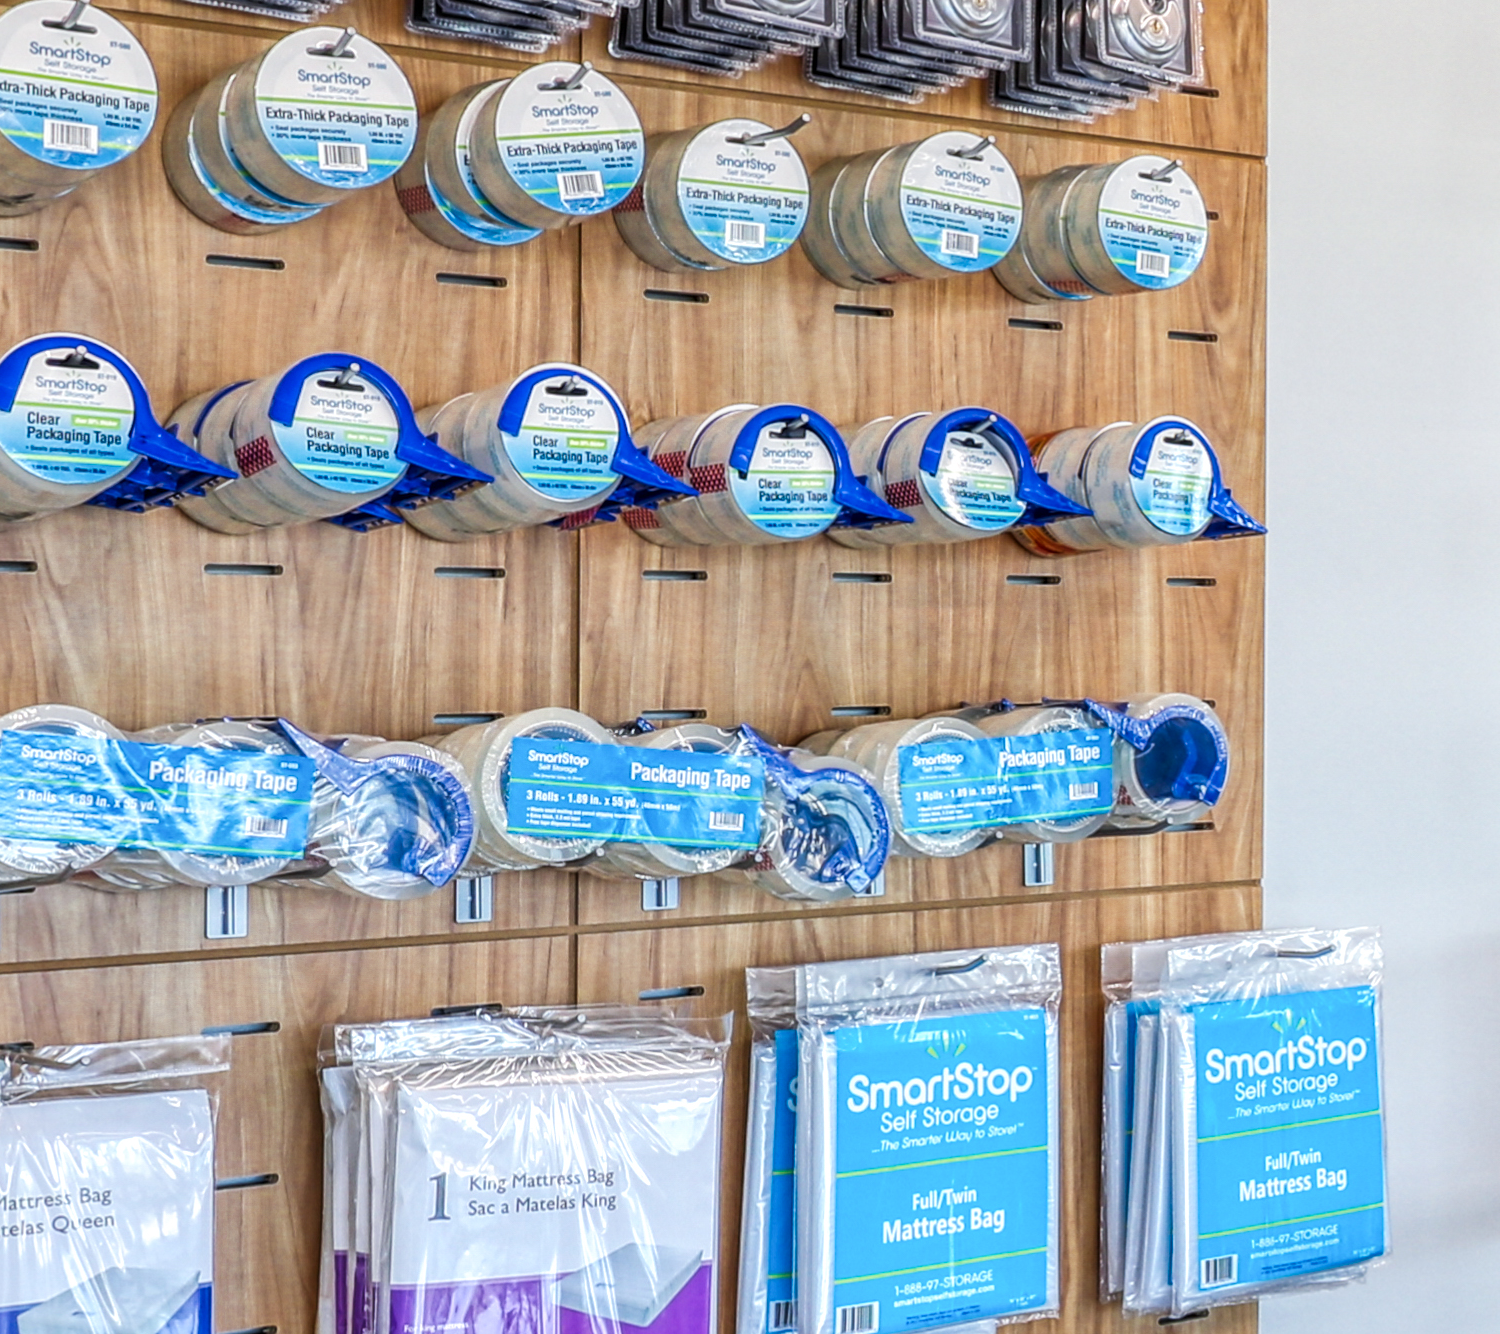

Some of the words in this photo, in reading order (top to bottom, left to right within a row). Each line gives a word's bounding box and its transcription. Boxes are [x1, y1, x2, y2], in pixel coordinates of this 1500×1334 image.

[29, 40, 111, 68] SmartStop
[298, 68, 370, 89] SmartStop
[59, 88, 120, 111] Packaging
[122, 93, 150, 112] Tape
[265, 107, 325, 123] Extra-Thick
[328, 110, 382, 127] Packaging
[384, 112, 409, 128] Tape
[35, 375, 107, 395] SmartStop
[27, 412, 59, 426] Clear
[27, 427, 91, 444] Packaging
[92, 430, 122, 445] Tape
[528, 749, 589, 768] SmartStop
[631, 762, 709, 789] Packaging
[714, 769, 750, 789] Tape
[526, 789, 533, 801] 3
[536, 790, 558, 803] Rolls
[568, 792, 586, 805] 1.89
[590, 793, 602, 805] in.
[604, 798, 610, 806] x
[612, 795, 625, 807] 55
[626, 796, 639, 809] yd.
[1205, 1035, 1367, 1084] SmartStop
[847, 1061, 1034, 1113] SmartStop
[1235, 1081, 1265, 1101] Self
[1272, 1072, 1339, 1096] Storage
[880, 1110, 917, 1134] Self
[922, 1103, 999, 1128] Storage
[902, 1132, 943, 1149] Smarter
[946, 1129, 973, 1145] Way
[975, 1128, 985, 1138] to
[1265, 1148, 1321, 1171] Full/Twin
[469, 1175, 506, 1193] King
[512, 1171, 581, 1189] Mattress
[588, 1169, 614, 1187] Bag
[1239, 1170, 1312, 1202] Mattress
[1316, 1167, 1347, 1191] Bag
[79, 1187, 112, 1207] Bag
[468, 1197, 495, 1216] Sac
[516, 1195, 576, 1212] Matelas
[581, 1192, 616, 1211] King
[913, 1185, 977, 1211] Full/Twin
[52, 1213, 115, 1233] Queen
[883, 1214, 964, 1244] Mattress
[970, 1207, 1005, 1233] Bag
[894, 1269, 993, 1295] 1-888-97-STORAGE
